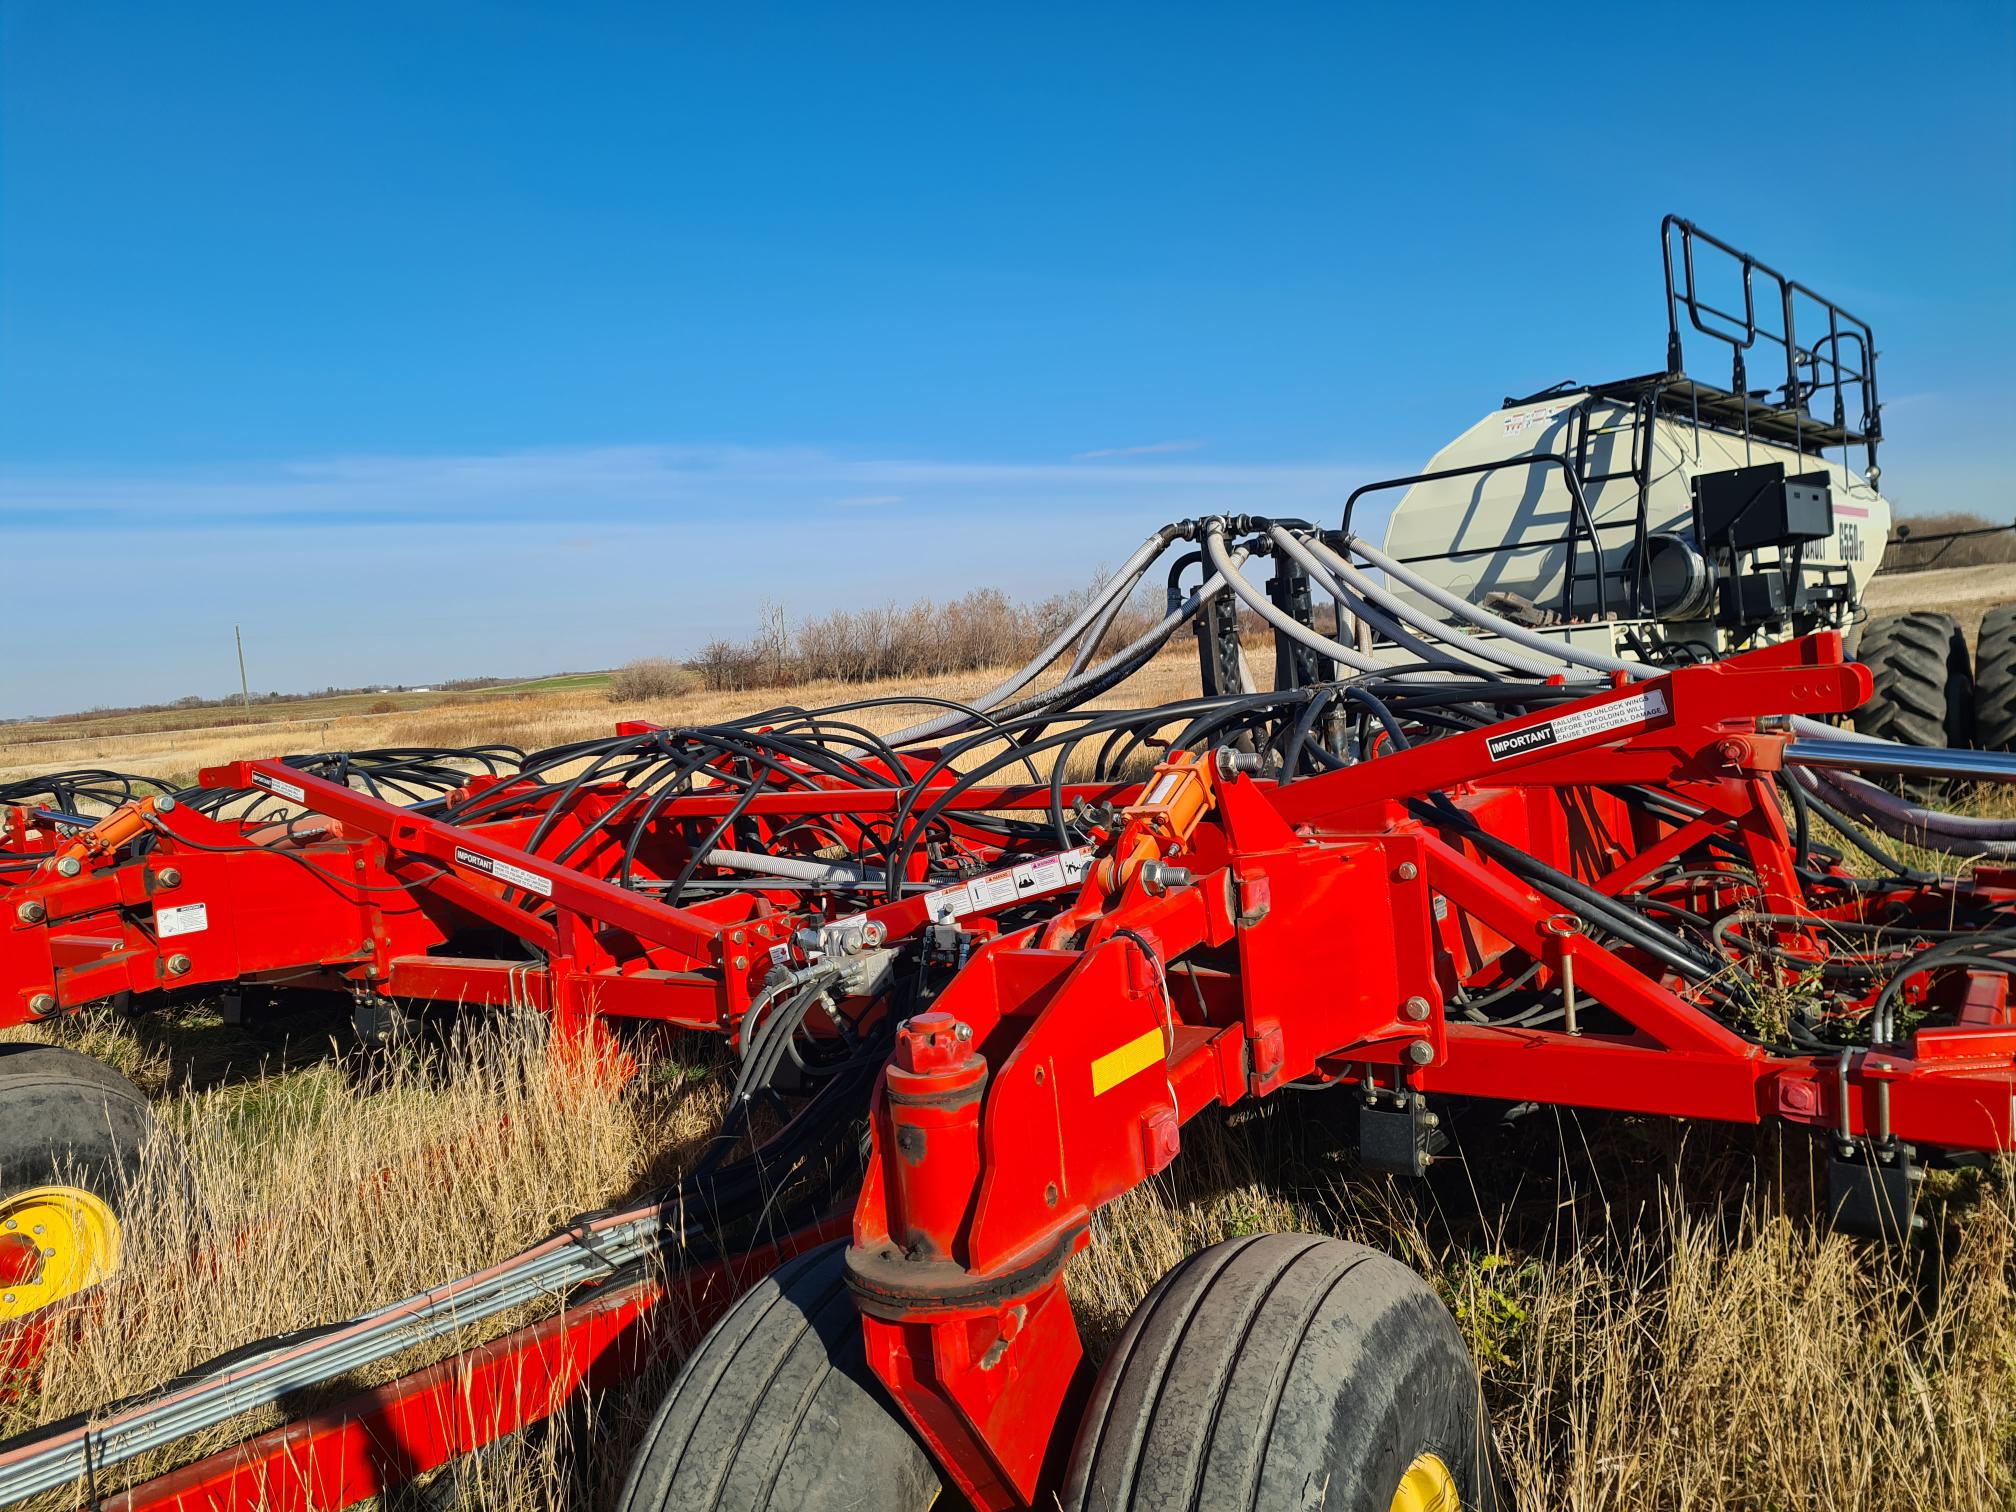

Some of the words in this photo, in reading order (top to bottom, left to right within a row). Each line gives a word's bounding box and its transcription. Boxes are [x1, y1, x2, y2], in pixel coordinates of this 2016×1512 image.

[1839, 522, 1859, 561] 6550
[1552, 714, 1581, 727] FAILURE
[1583, 711, 1593, 720] TO
[1594, 703, 1624, 716] UNLOCK
[1624, 695, 1649, 707] WINGS
[1555, 722, 1583, 735] BEFORE
[1585, 710, 1626, 726] UNFOLDING
[1626, 706, 1644, 714] WILL
[1491, 728, 1552, 754] IMPORTANT
[1557, 729, 1581, 741] CAUSE
[1582, 717, 1630, 734] STRUCTURAL
[457, 849, 493, 870] IMPORTANT
